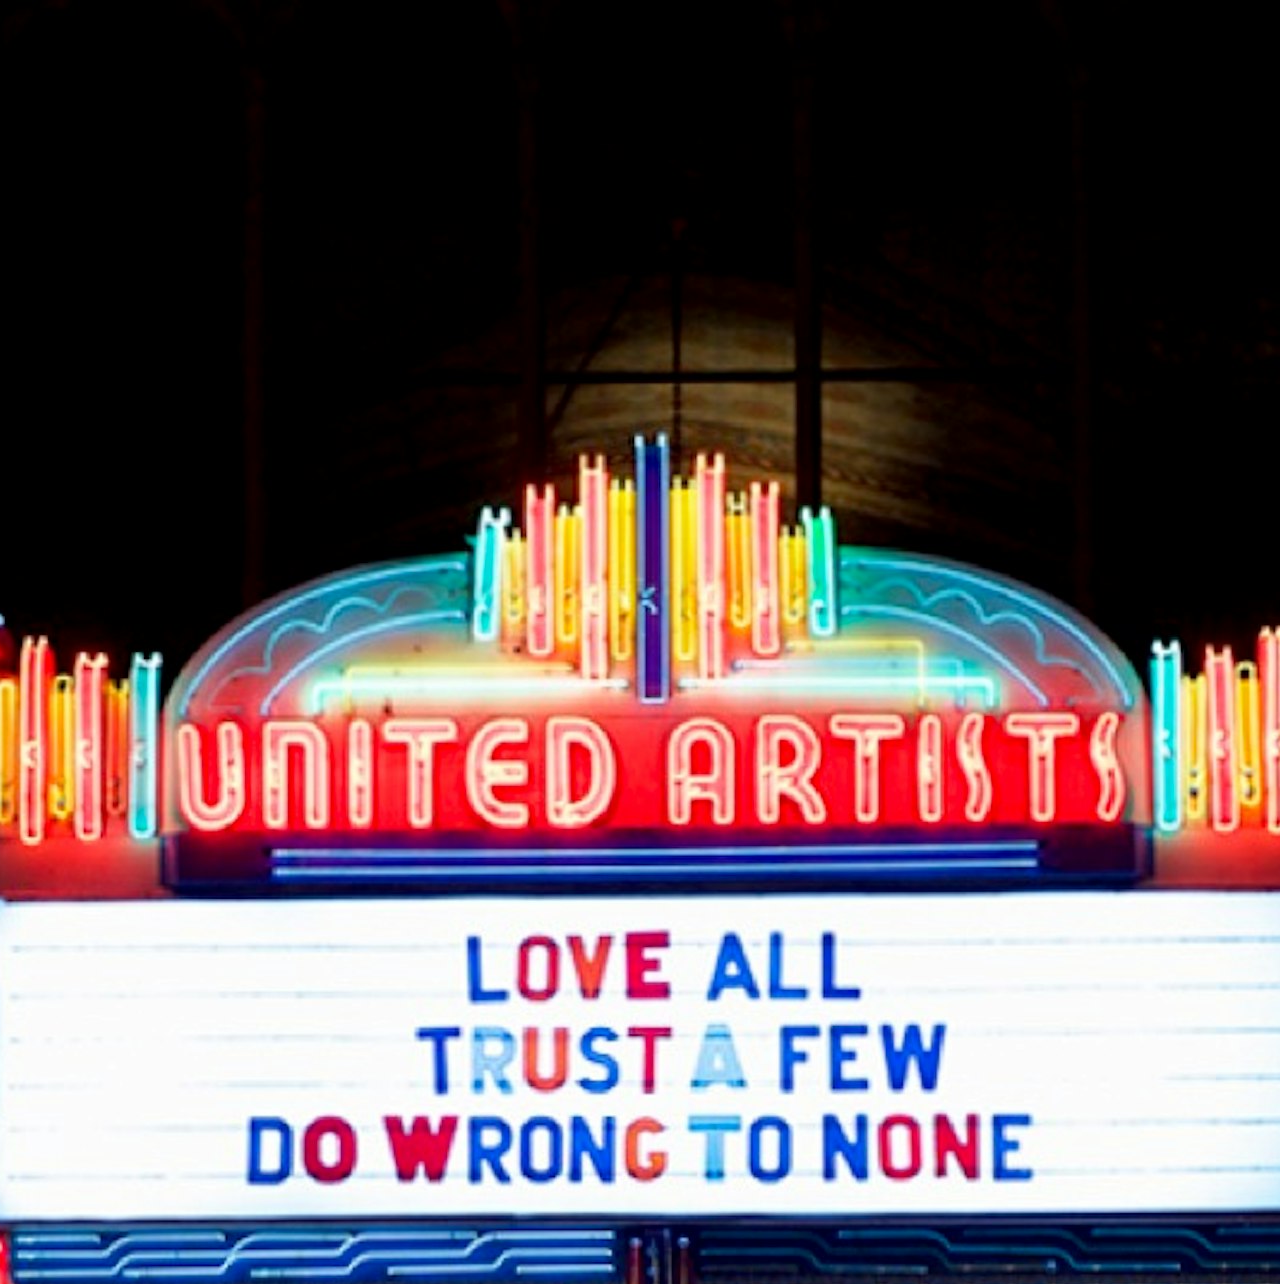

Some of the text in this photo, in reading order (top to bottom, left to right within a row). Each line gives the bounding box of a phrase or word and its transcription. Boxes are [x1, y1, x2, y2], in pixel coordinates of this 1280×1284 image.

[177, 712, 1126, 831] UNITED ARTISTS
[466, 931, 862, 1004] LOVE ALL
[415, 1023, 947, 1096] TRUST A FEW
[245, 1113, 1034, 1186] DO WRONG TO NONE
